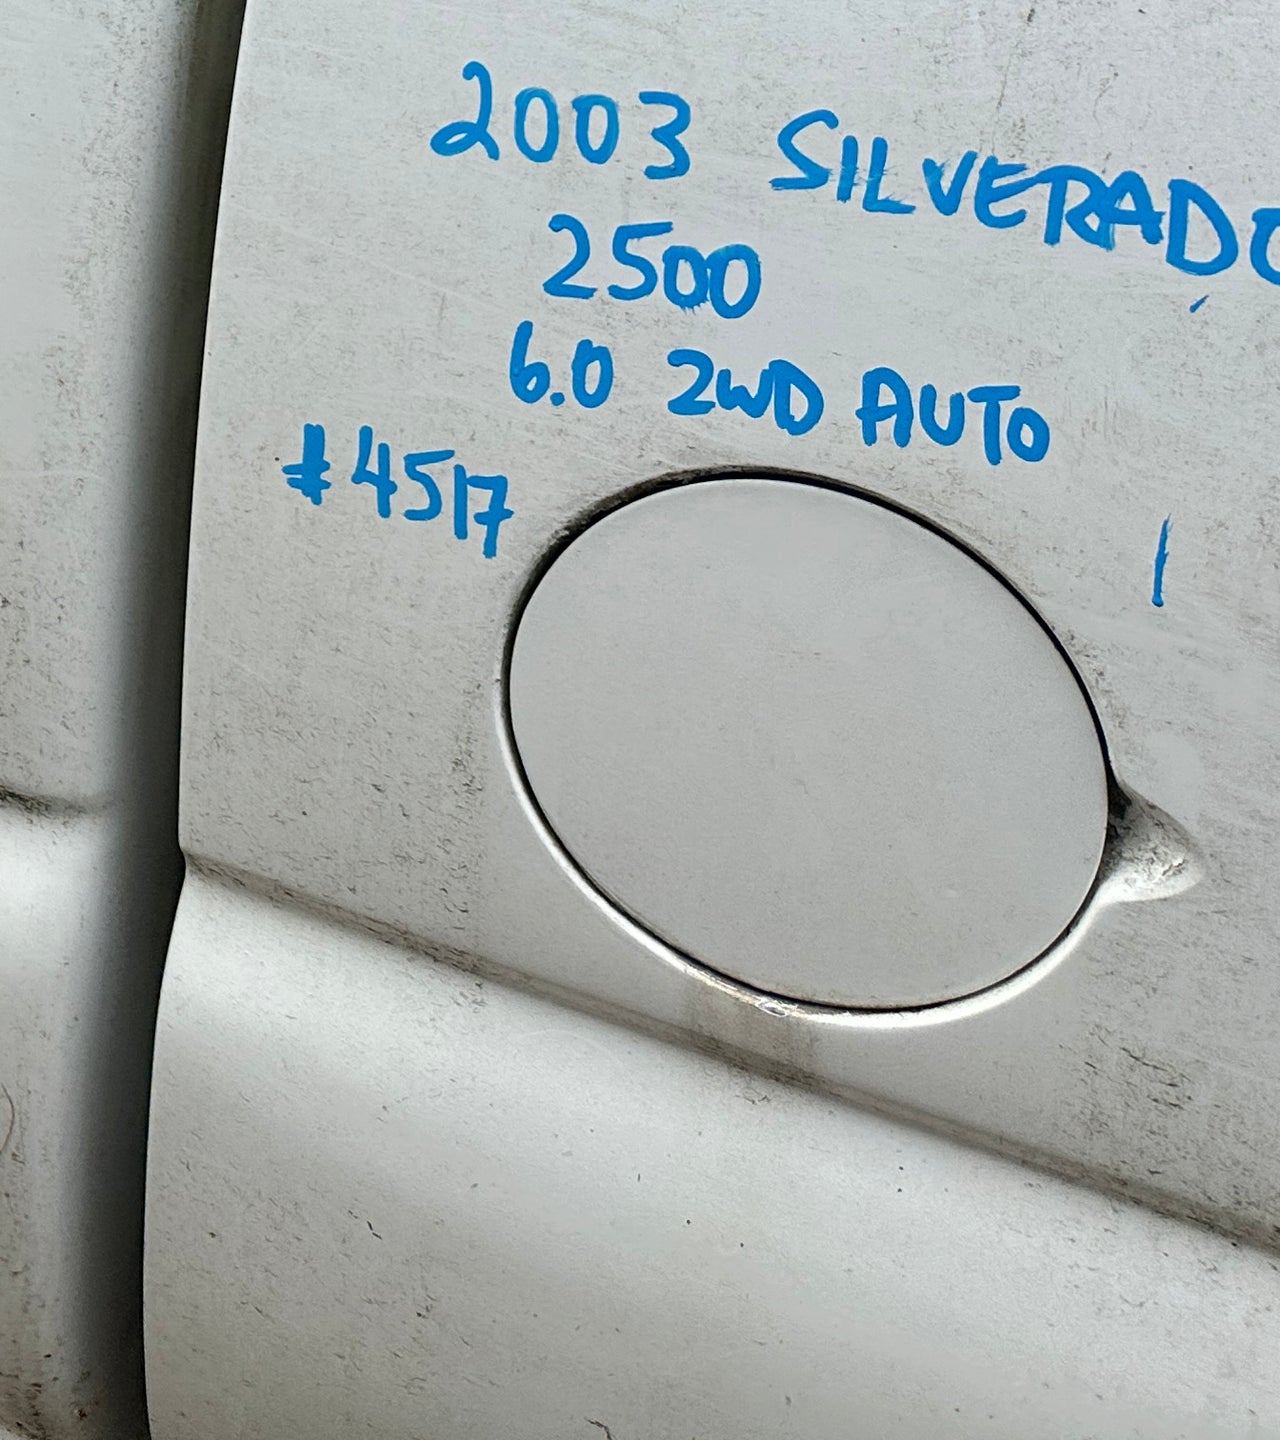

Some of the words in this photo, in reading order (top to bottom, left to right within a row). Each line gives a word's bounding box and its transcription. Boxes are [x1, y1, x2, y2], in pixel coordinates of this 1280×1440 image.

[429, 61, 691, 181] 2003
[542, 213, 762, 320] 2500
[509, 320, 615, 409] 6.0
[666, 348, 825, 437] 2WD
[855, 366, 1051, 466] AUTO
[281, 423, 515, 559] #4517
